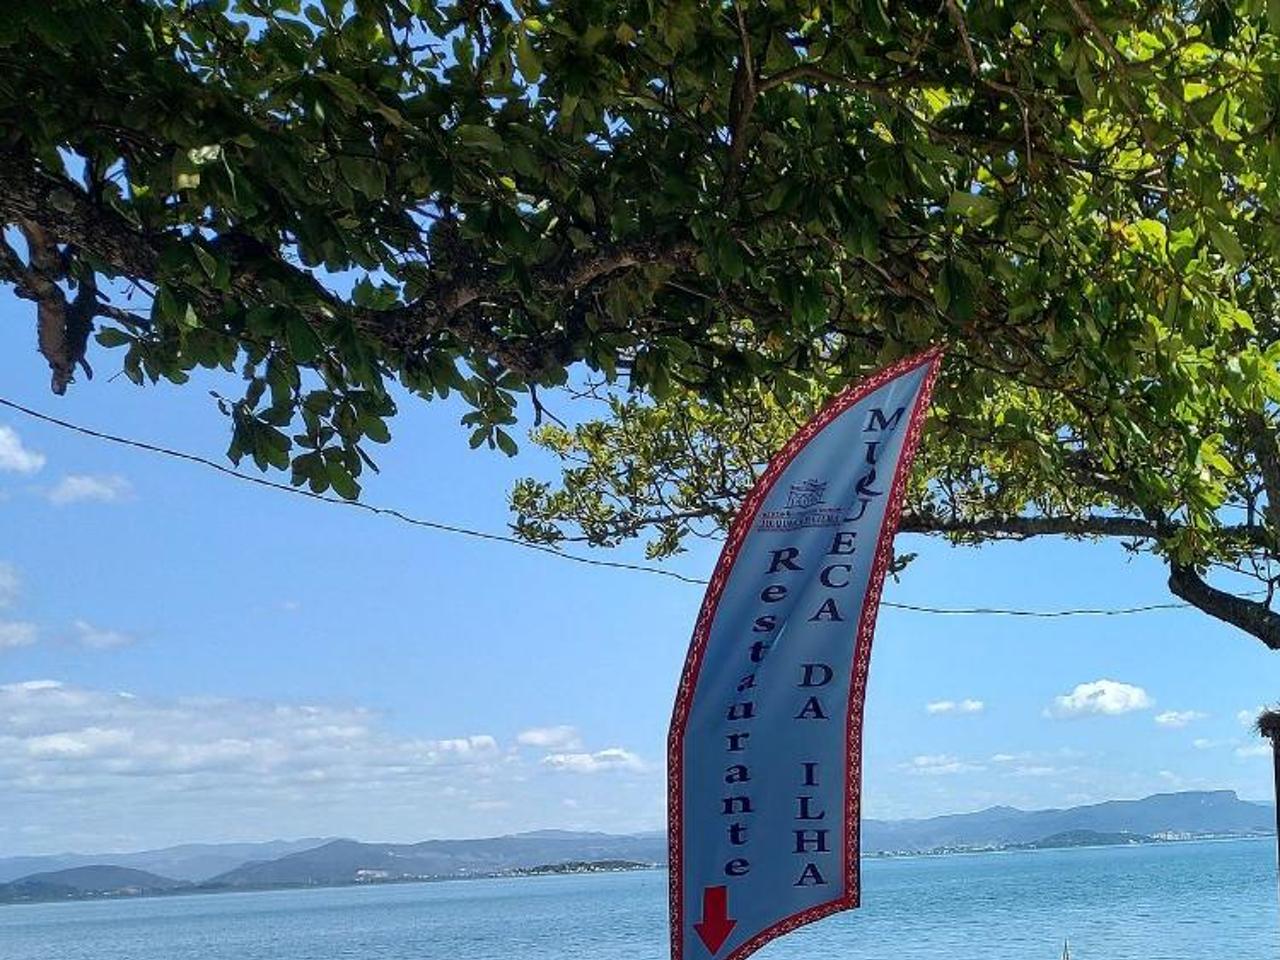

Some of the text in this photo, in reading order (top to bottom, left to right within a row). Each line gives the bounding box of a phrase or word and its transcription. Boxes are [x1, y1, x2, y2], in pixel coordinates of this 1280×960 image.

[720, 547, 804, 877] Restaurante
[793, 662, 834, 720] DA
[792, 762, 831, 887] ILHA
